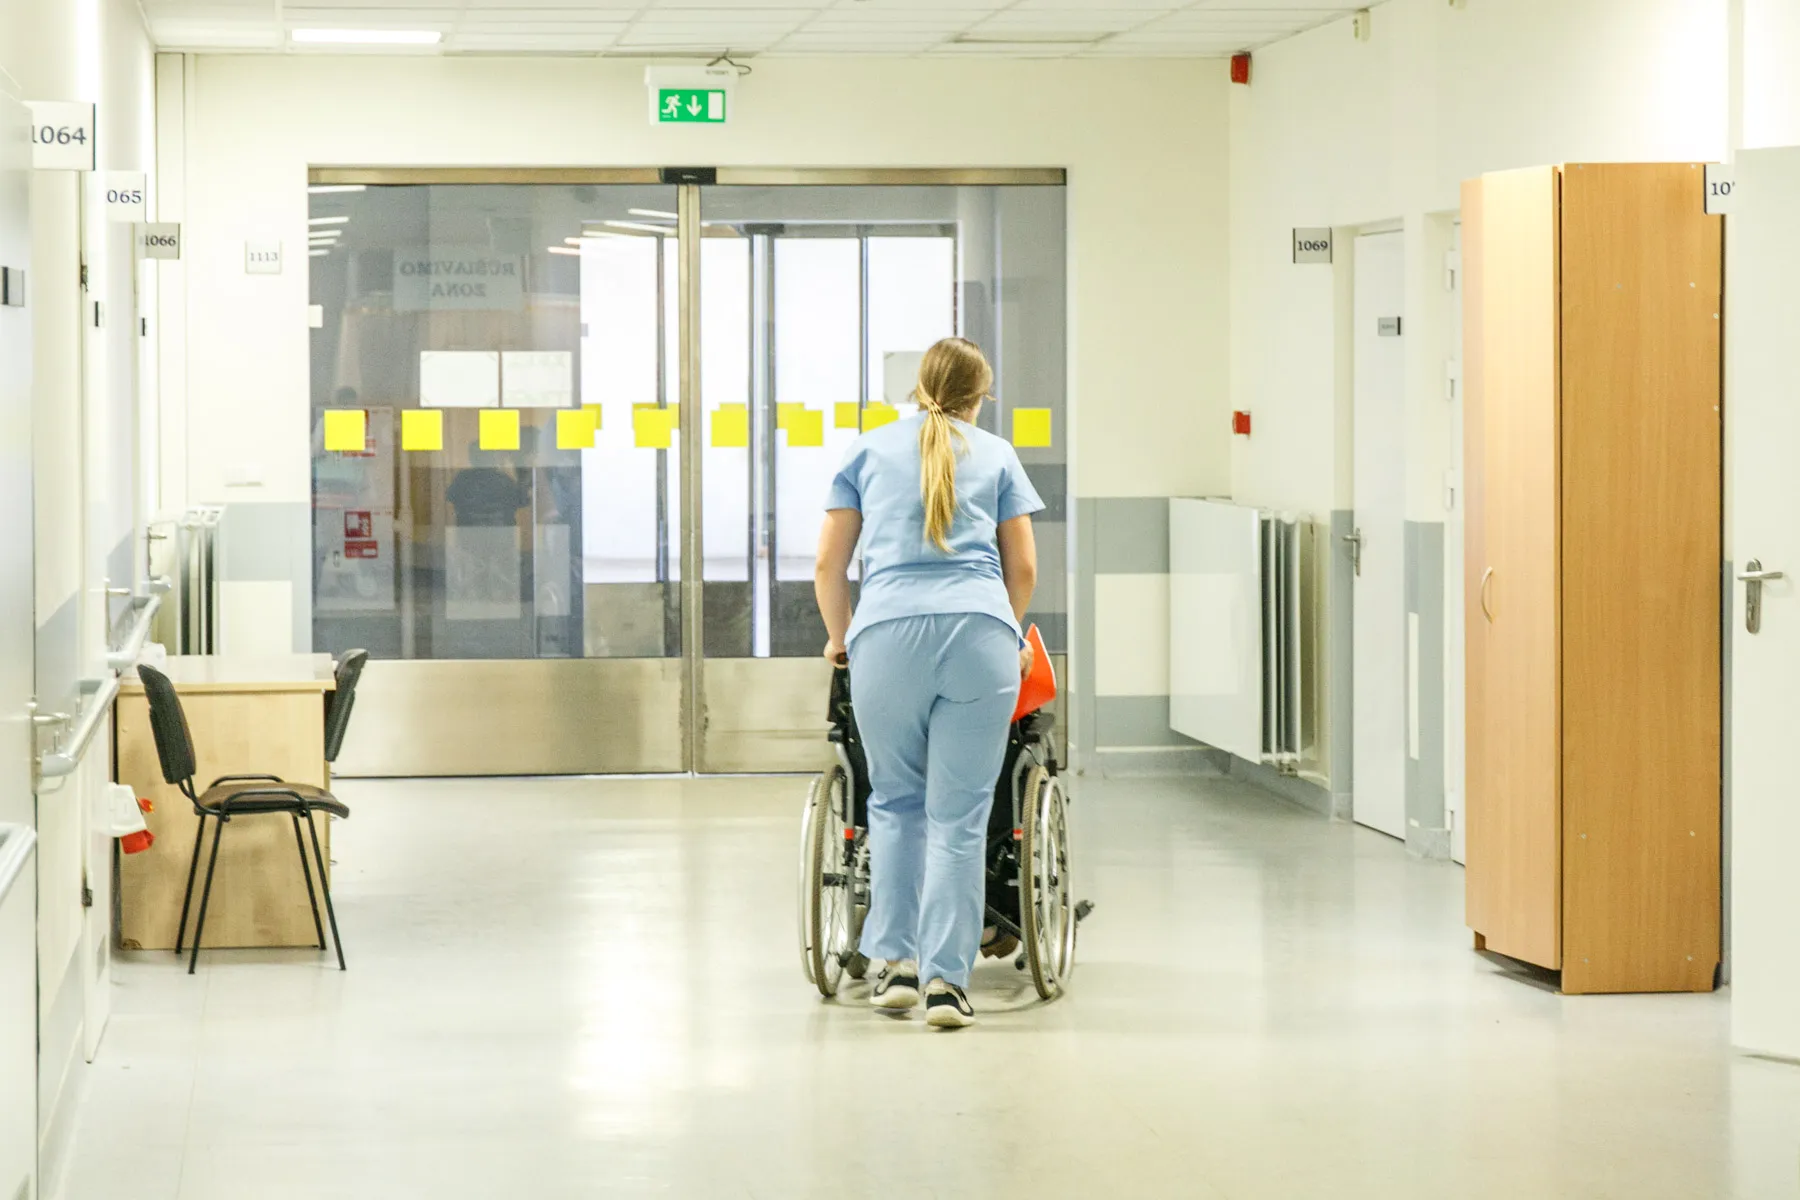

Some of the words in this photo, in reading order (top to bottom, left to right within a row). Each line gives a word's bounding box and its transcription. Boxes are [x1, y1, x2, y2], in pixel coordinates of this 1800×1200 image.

[1711, 181, 1735, 196] 10
[107, 189, 142, 204] 065
[1297, 240, 1328, 251] 1069
